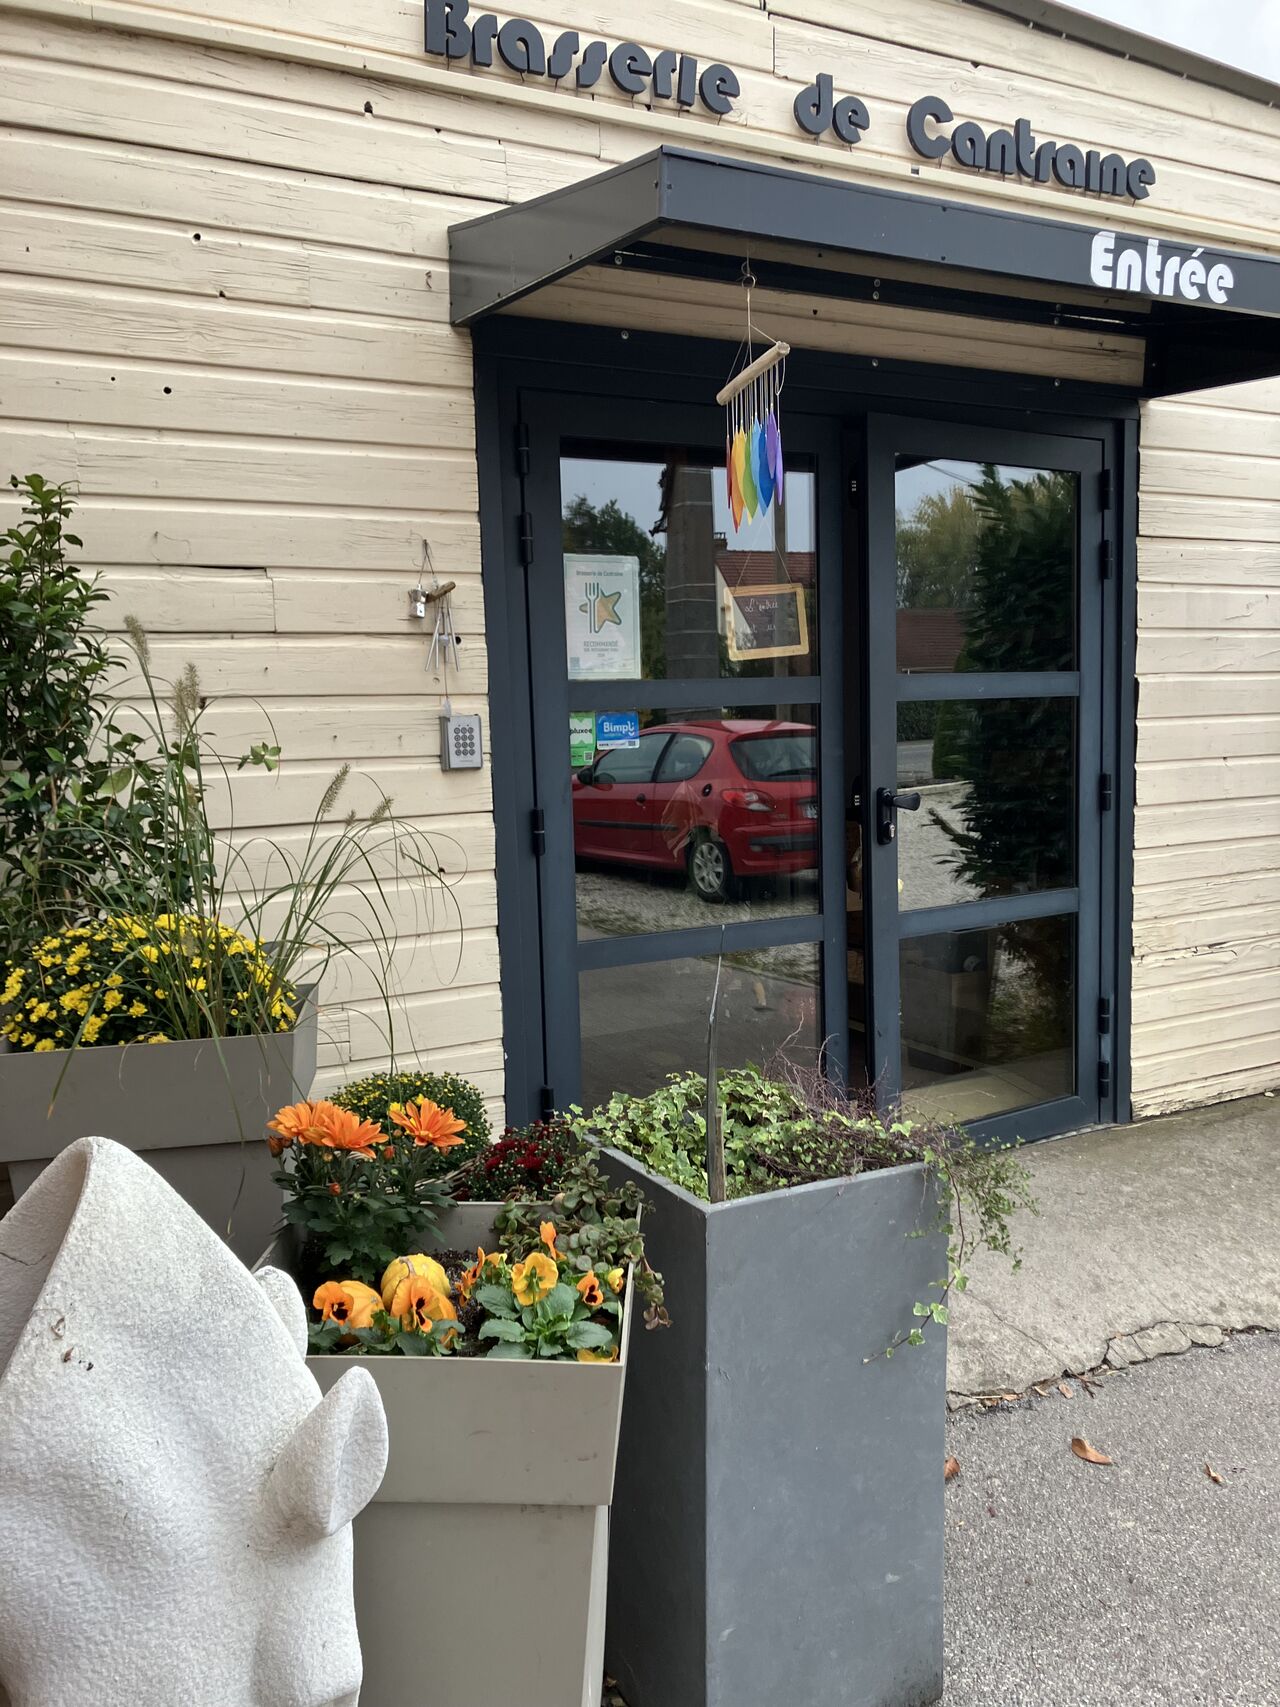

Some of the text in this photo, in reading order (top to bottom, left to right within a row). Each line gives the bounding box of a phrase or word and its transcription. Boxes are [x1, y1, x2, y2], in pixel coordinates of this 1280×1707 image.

[424, 0, 1156, 200] Brasserie de Cantraine
[1090, 231, 1234, 304] Entrée
[603, 720, 635, 736] Bimpli
